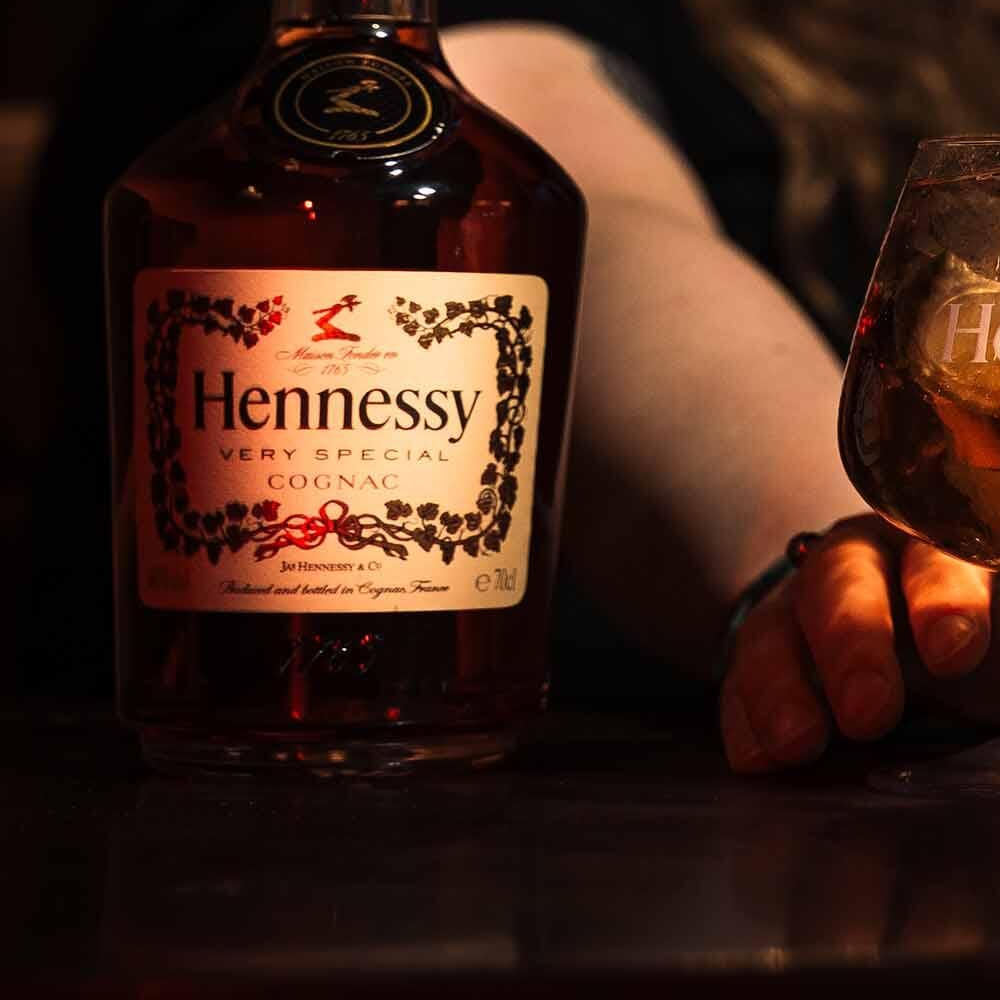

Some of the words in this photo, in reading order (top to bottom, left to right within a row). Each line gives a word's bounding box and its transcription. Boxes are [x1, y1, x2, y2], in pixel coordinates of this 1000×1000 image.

[193, 369, 483, 444] Hennessy
[218, 448, 297, 462] VERY
[314, 448, 449, 462] SPECIAL
[267, 473, 401, 490] COGNAC
[297, 561, 353, 572] HENNESSY
[273, 583, 300, 595] and
[301, 583, 338, 595] bottled
[340, 585, 354, 595] in
[408, 578, 452, 594] France
